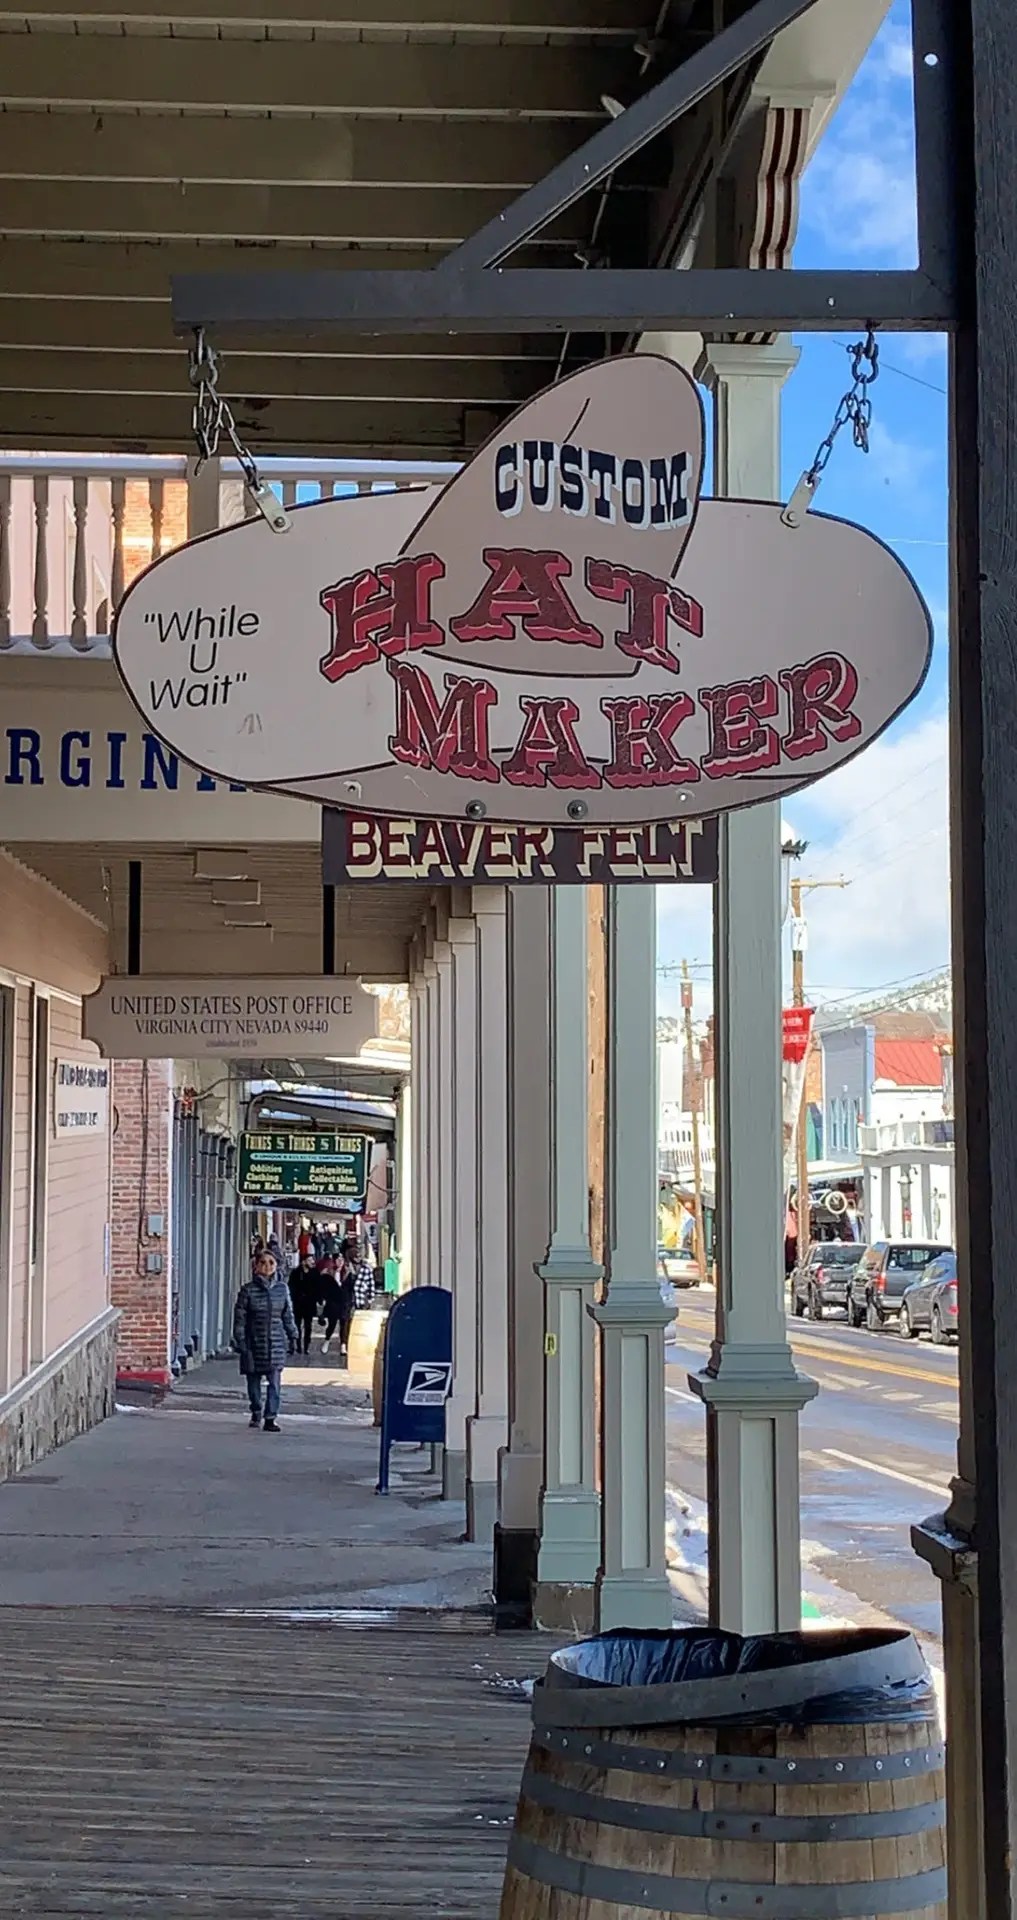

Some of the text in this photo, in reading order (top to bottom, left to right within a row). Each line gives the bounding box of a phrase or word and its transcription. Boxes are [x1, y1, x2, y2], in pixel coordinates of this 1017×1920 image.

[494, 440, 693, 531] CUSTOM
[144, 604, 260, 643] "While
[320, 548, 704, 683] HAT
[190, 641, 218, 674] U
[151, 672, 247, 711] Wait"
[387, 651, 862, 790] MAKER
[345, 812, 703, 878] BEAVER FELT
[111, 996, 353, 1016] UNITED STATES POST OFFICE
[135, 1019, 329, 1035] VIRGINIA CITY NEVADA 89440
